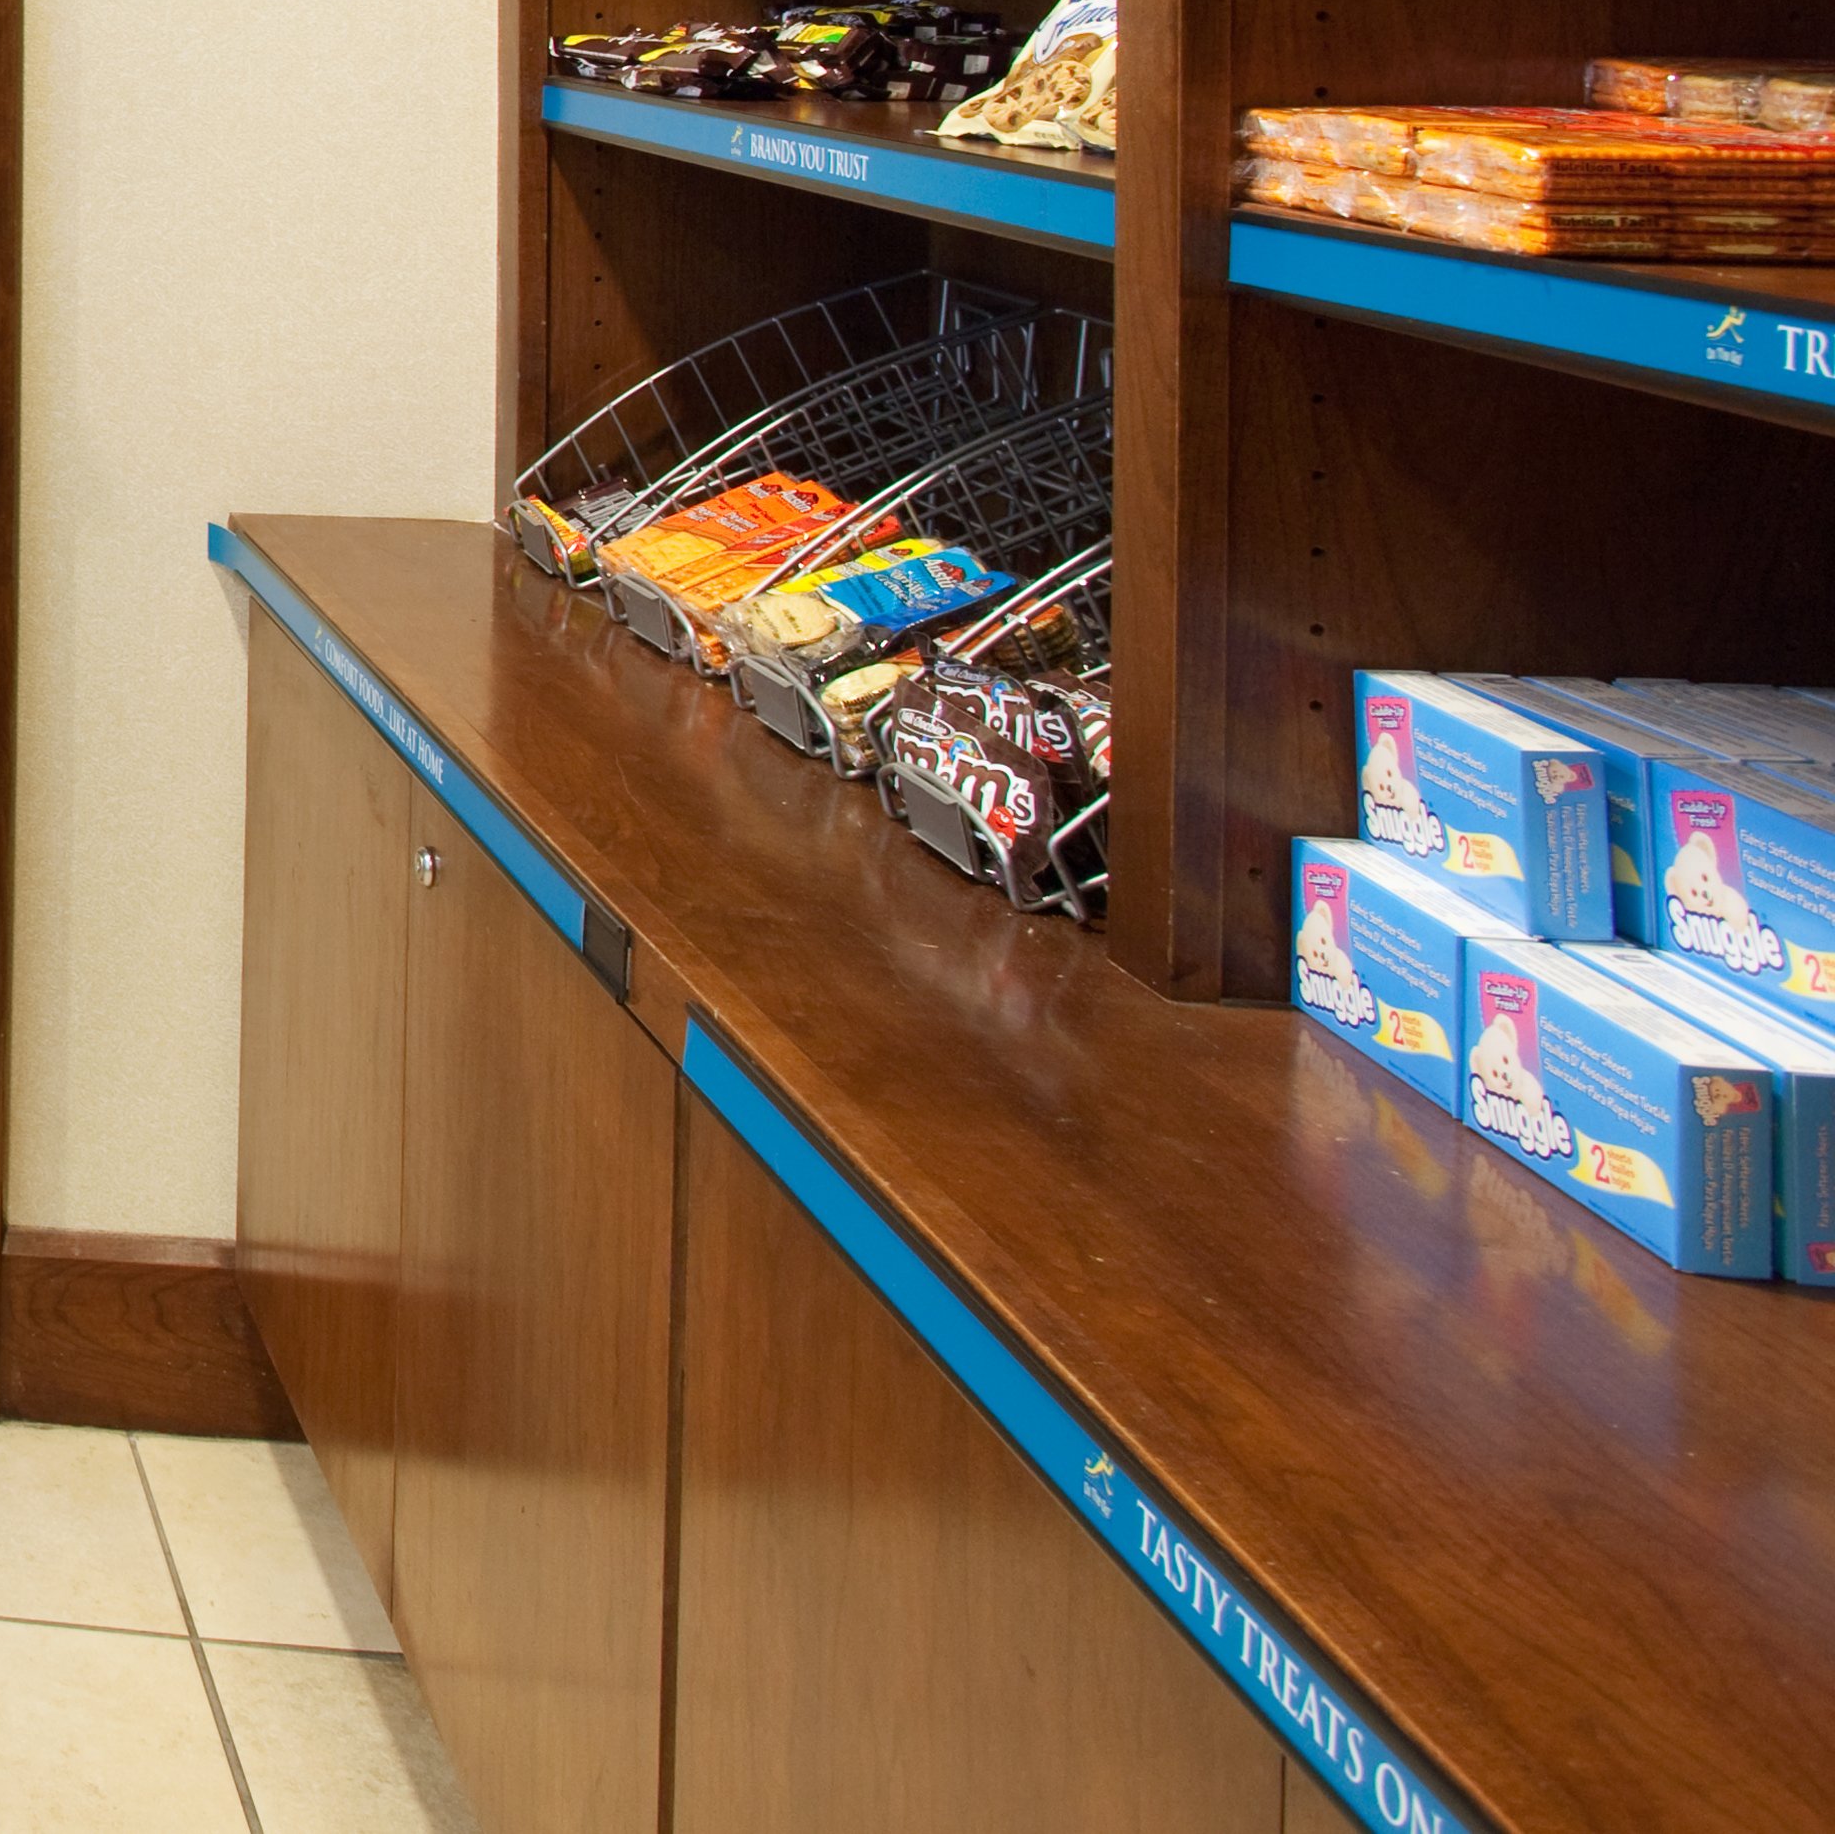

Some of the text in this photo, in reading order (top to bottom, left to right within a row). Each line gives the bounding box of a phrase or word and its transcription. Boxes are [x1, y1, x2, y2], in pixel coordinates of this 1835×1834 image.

[750, 132, 869, 182] BRANDS YOU TRUST
[1777, 324, 1835, 380] TR
[921, 557, 958, 589] Austin
[325, 639, 358, 691] COMFORT
[406, 726, 417, 754] AT
[418, 735, 444, 785] HOME
[1363, 790, 1446, 857] Snuggle
[1677, 799, 1727, 819] Cuddle-Up
[1689, 814, 1719, 828] Fresh
[1458, 835, 1474, 869] 2
[1740, 829, 1809, 868] Fabric Softener
[1666, 894, 1784, 975] Snuggle
[1297, 956, 1377, 1028] Snuggle
[1484, 980, 1530, 1003] Cuddle-Up
[1804, 954, 1827, 993] 2
[1495, 996, 1522, 1013] Fresh
[1389, 1010, 1404, 1045] 2
[1470, 1073, 1574, 1161] Snuggle
[1691, 1076, 1720, 1126] Snuggle
[1591, 1144, 1610, 1184] 2
[1136, 1499, 1230, 1637] TASTY
[1236, 1604, 1365, 1785] TREATS
